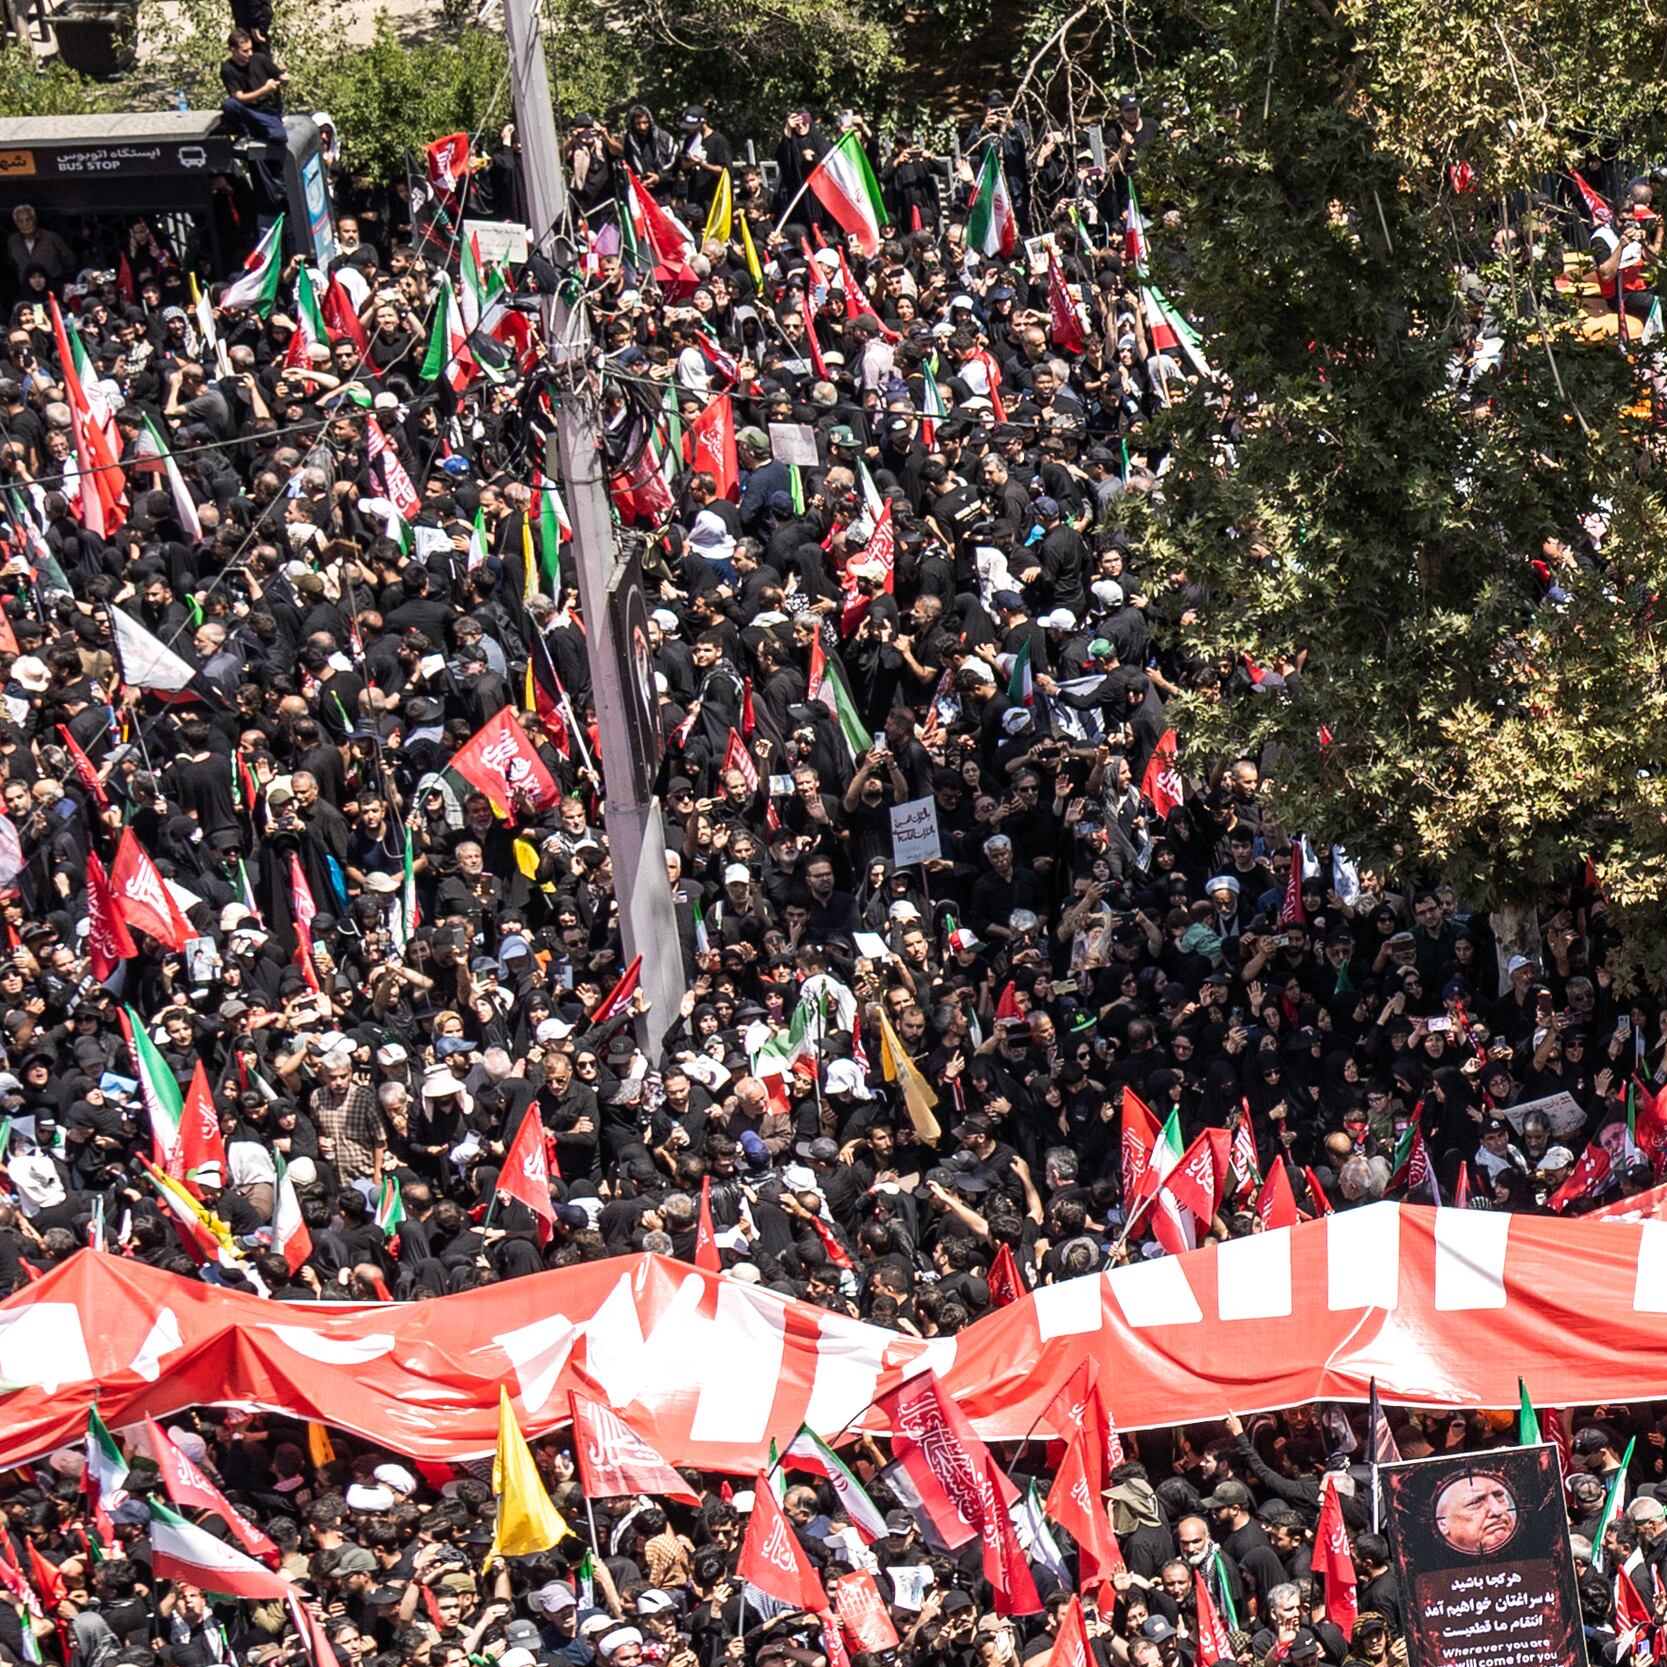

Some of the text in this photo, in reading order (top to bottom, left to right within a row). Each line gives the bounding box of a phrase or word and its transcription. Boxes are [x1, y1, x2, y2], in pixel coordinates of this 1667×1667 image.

[57, 148, 160, 163] ایستگاه اتوبوس
[58, 161, 121, 172] BUS STOP
[1450, 1573, 1522, 1592] هر کجا باشید
[1424, 1599, 1445, 1618] آمد
[1446, 1597, 1492, 1618] خواهیم
[1442, 1614, 1544, 1637] انتقام ما قطعیست
[1442, 1638, 1551, 1659] Wherever you are
[1515, 1653, 1536, 1666] for
[1537, 1650, 1558, 1663] you
